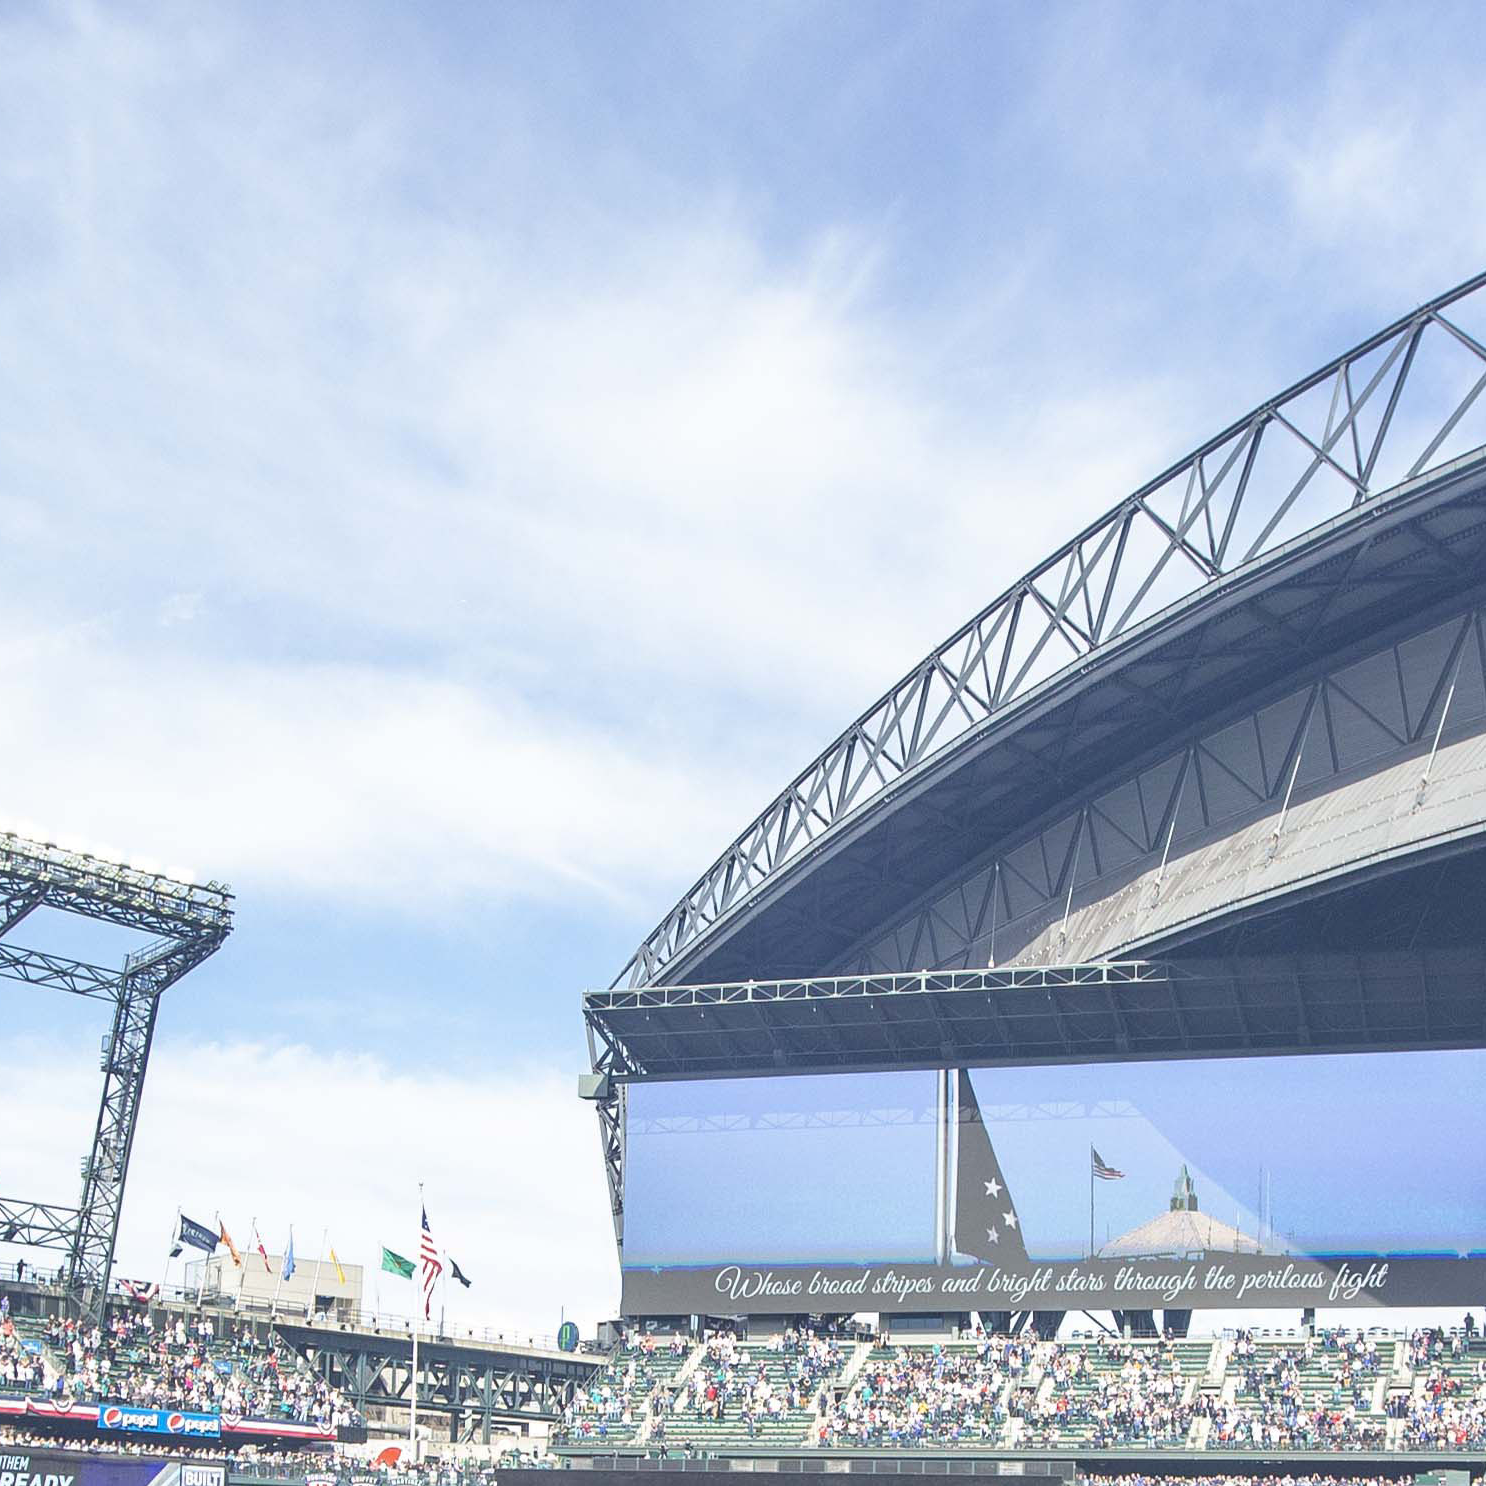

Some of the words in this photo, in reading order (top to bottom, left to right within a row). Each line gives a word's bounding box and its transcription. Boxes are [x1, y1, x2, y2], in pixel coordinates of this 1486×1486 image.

[714, 1266, 803, 1300] Whose
[808, 1270, 872, 1296] broad
[871, 1270, 936, 1302] stripes
[941, 1268, 982, 1293] and
[985, 1268, 1051, 1304] bright
[1055, 1268, 1106, 1292] stars
[1113, 1266, 1199, 1301] through
[1204, 1265, 1236, 1290] the
[1237, 1264, 1326, 1299] perilous
[1328, 1262, 1388, 1301] fight
[121, 1412, 158, 1430] pepsi
[184, 1416, 219, 1434] pepsi
